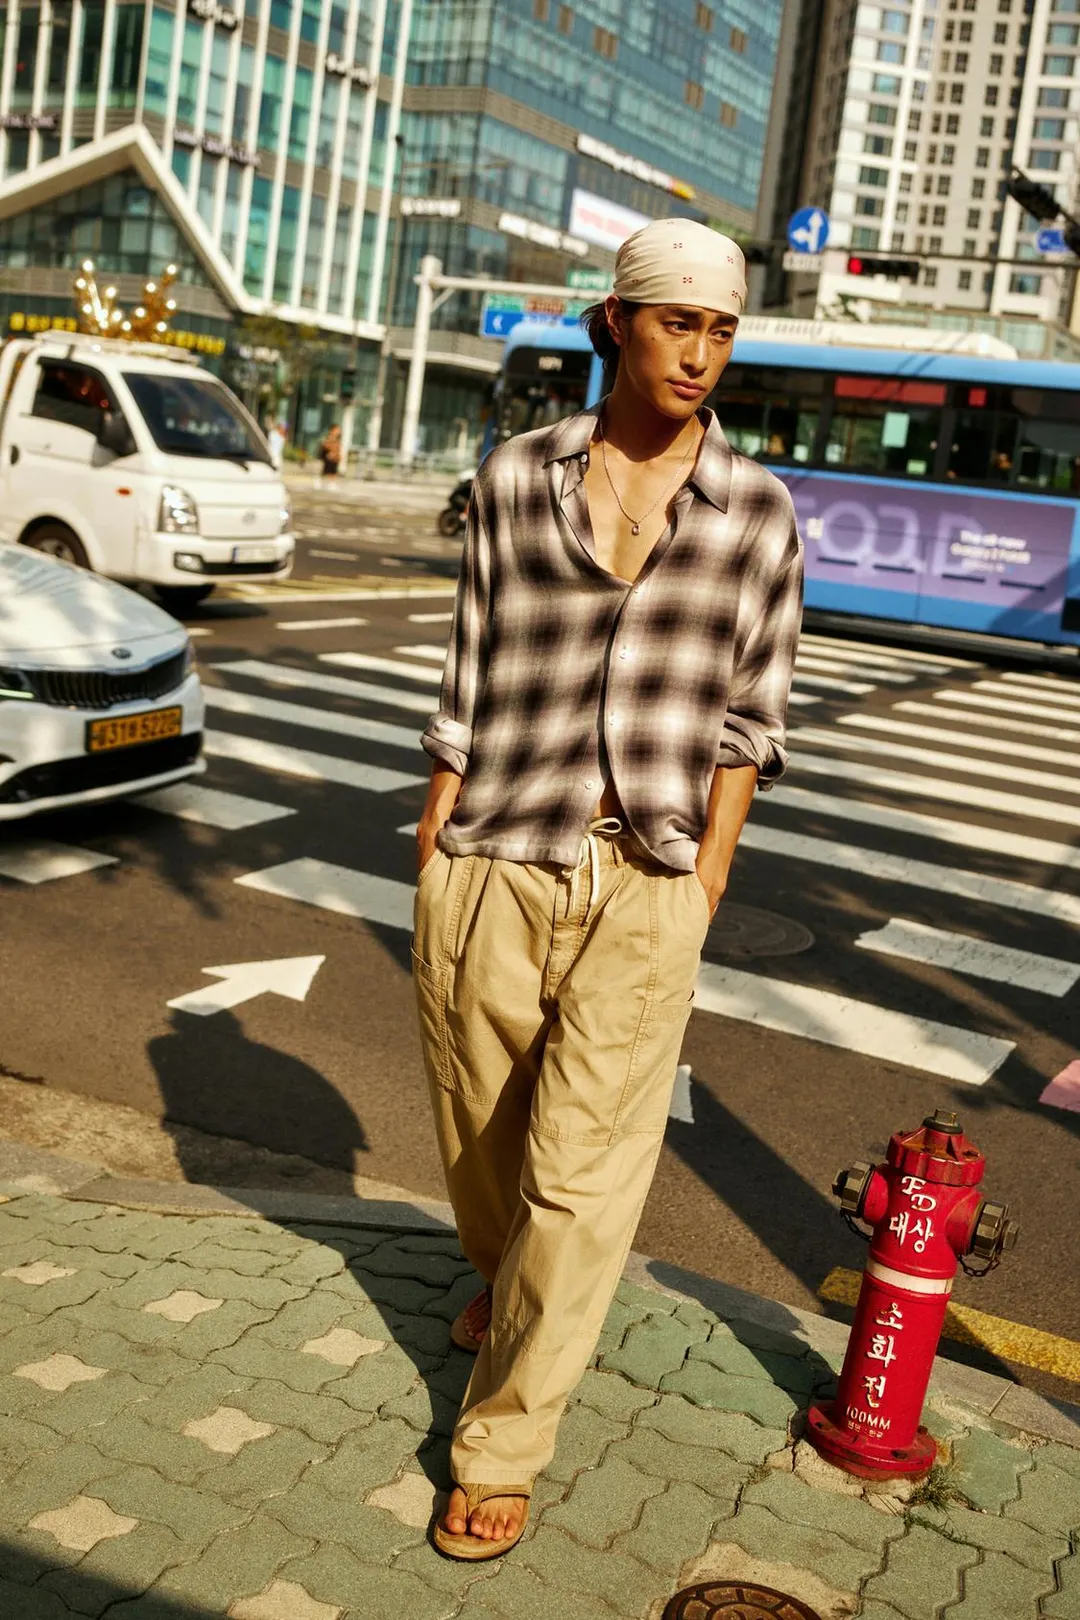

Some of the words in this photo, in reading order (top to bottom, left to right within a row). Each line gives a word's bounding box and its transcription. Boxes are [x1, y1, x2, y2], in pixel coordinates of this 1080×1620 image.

[889, 1211, 934, 1253] 대상
[861, 1302, 903, 1408] 소화전
[846, 1404, 891, 1430] 100MM
